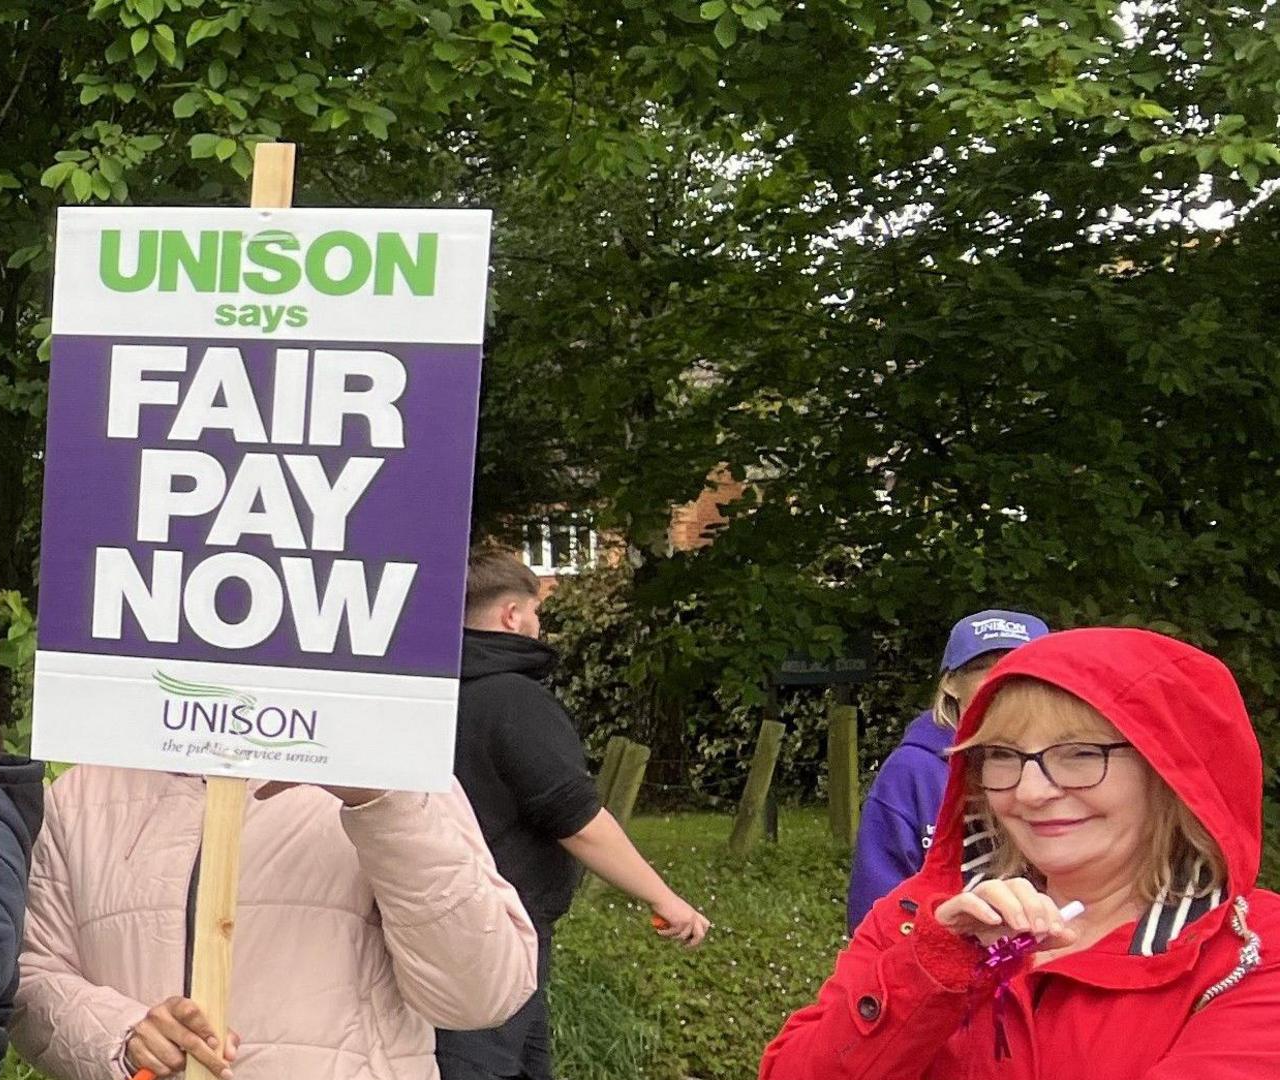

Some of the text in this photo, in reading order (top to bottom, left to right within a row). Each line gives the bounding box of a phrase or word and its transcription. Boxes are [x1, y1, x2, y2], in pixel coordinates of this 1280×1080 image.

[98, 230, 439, 297] UNISON
[214, 304, 309, 333] says
[107, 344, 407, 449] FAIR
[137, 448, 385, 552] PAY
[92, 547, 418, 656] NOW
[162, 738, 186, 752] the
[285, 751, 328, 765] union
[163, 699, 318, 740] UNISON
